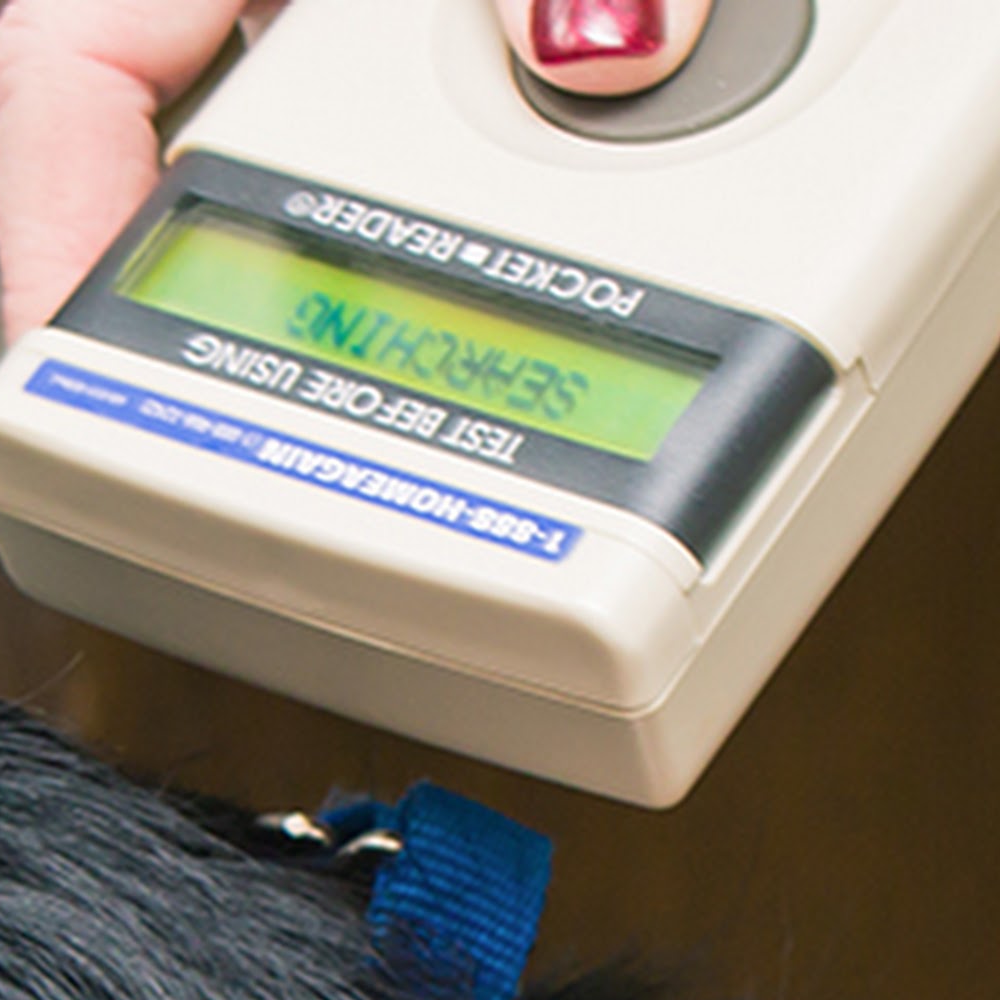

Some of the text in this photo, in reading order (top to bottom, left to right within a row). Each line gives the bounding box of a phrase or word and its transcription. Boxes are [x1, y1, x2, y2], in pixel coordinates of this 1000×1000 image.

[481, 248, 644, 317] POCKET
[181, 332, 304, 392] USING
[284, 291, 591, 421] SEARCHING
[301, 367, 448, 436] BEFORE
[440, 419, 525, 465] TEST
